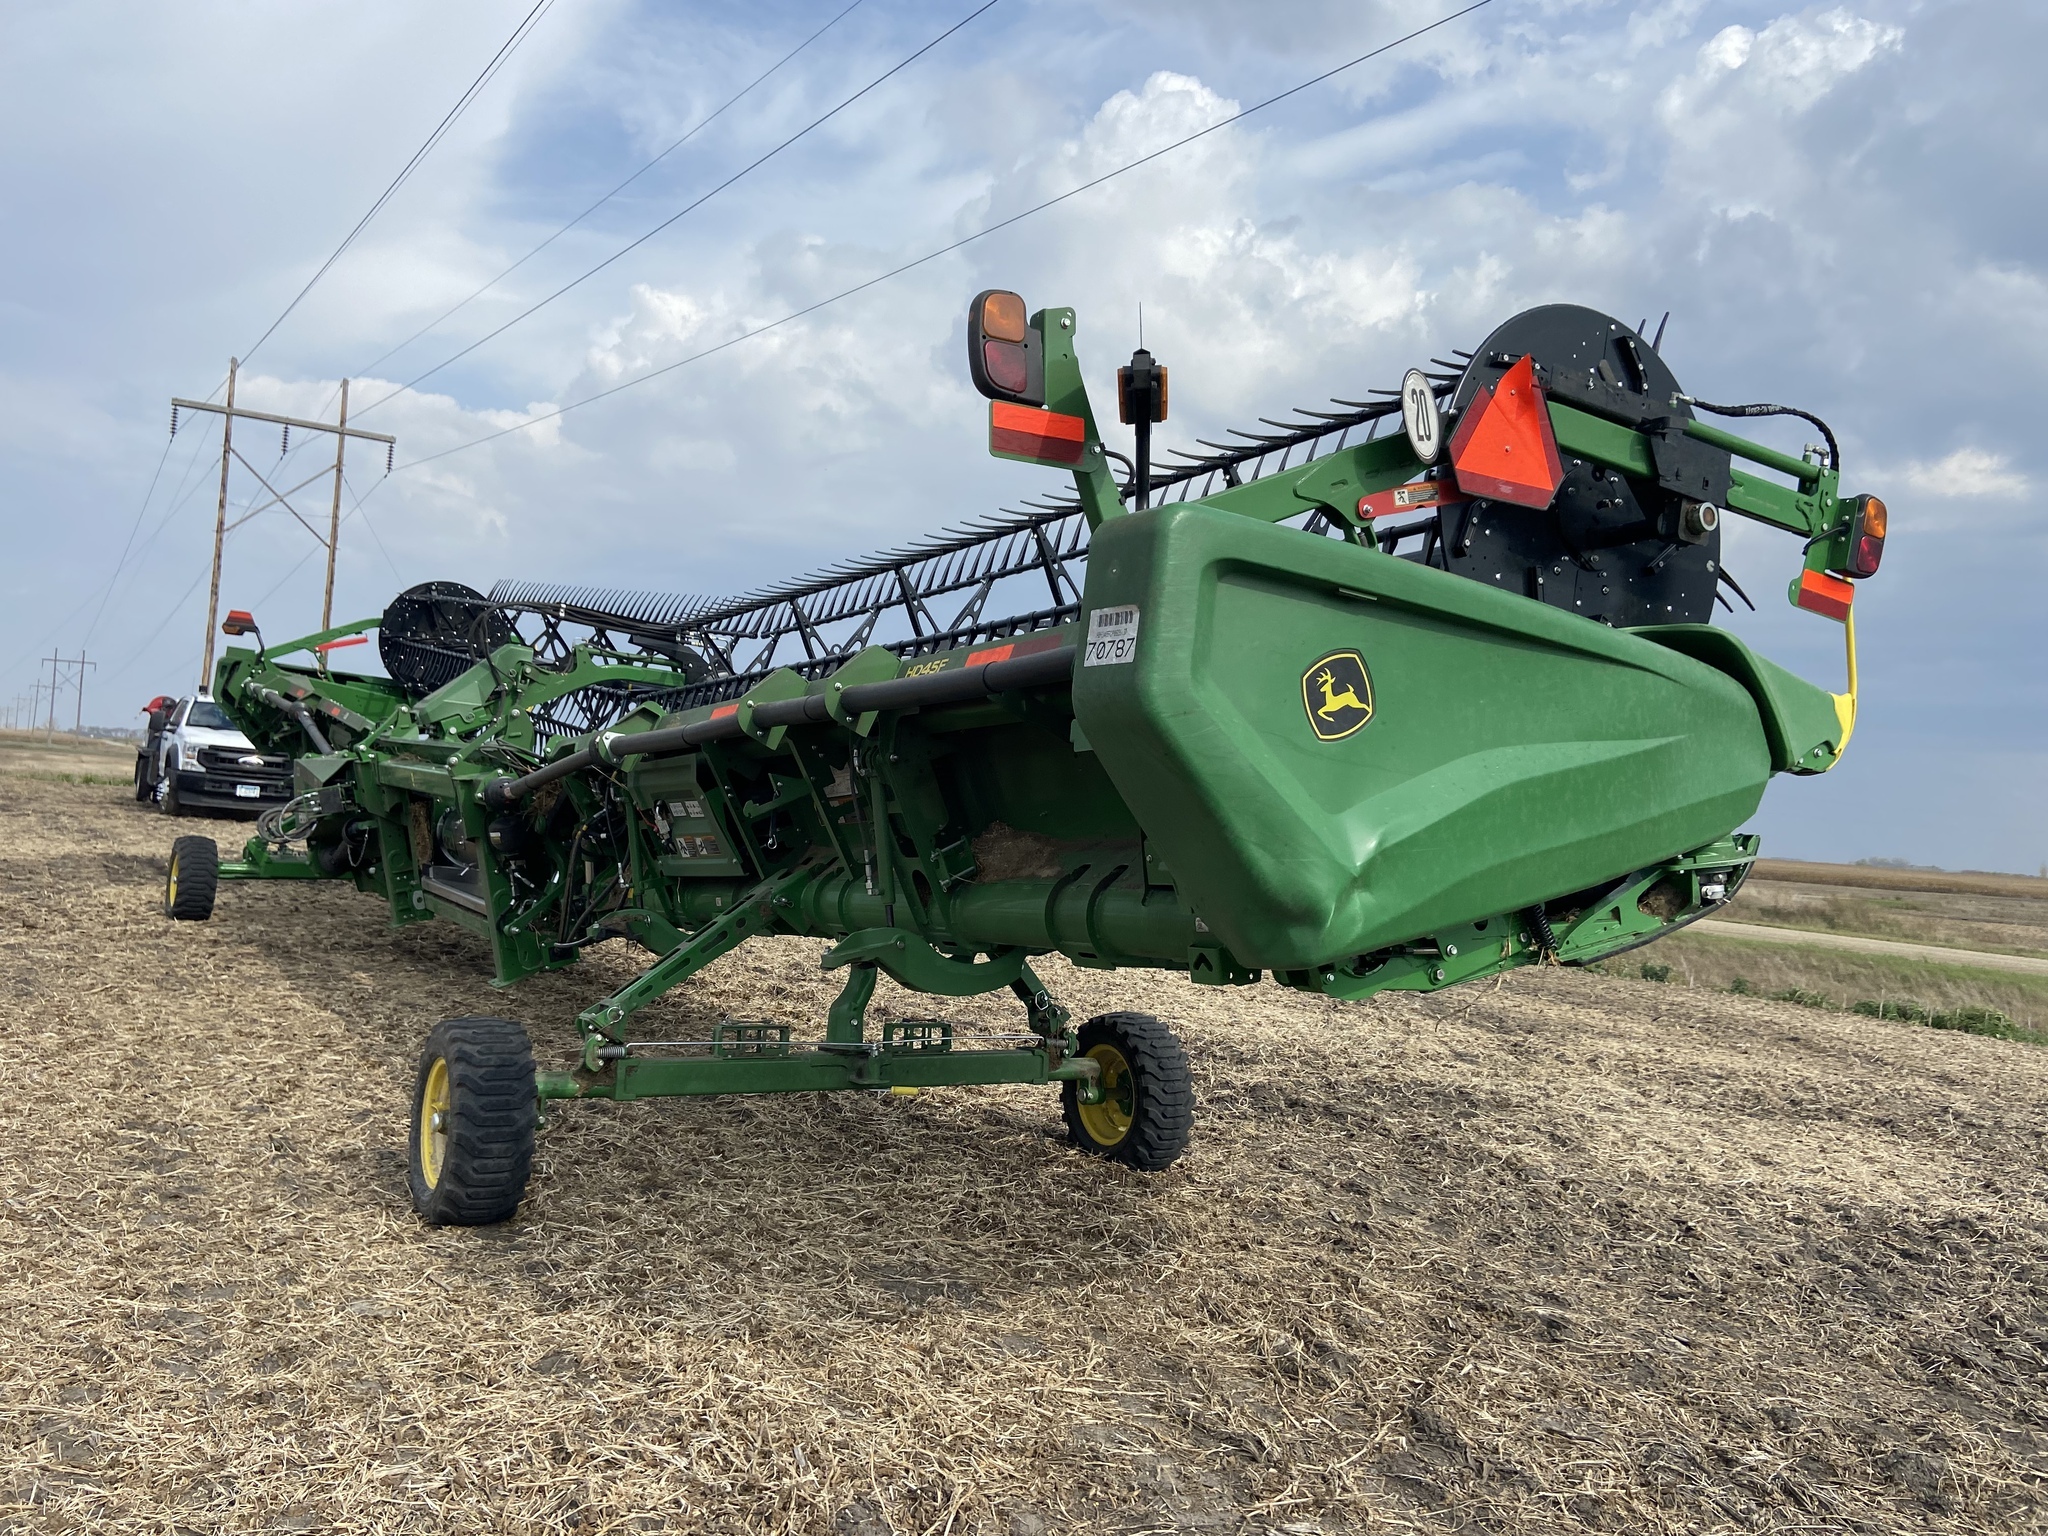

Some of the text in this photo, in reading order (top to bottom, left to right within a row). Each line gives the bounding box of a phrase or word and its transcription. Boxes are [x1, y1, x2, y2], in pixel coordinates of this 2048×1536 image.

[1411, 388, 1431, 441] 20
[1086, 637, 1135, 661] 70787
[905, 658, 950, 678] HD45F
